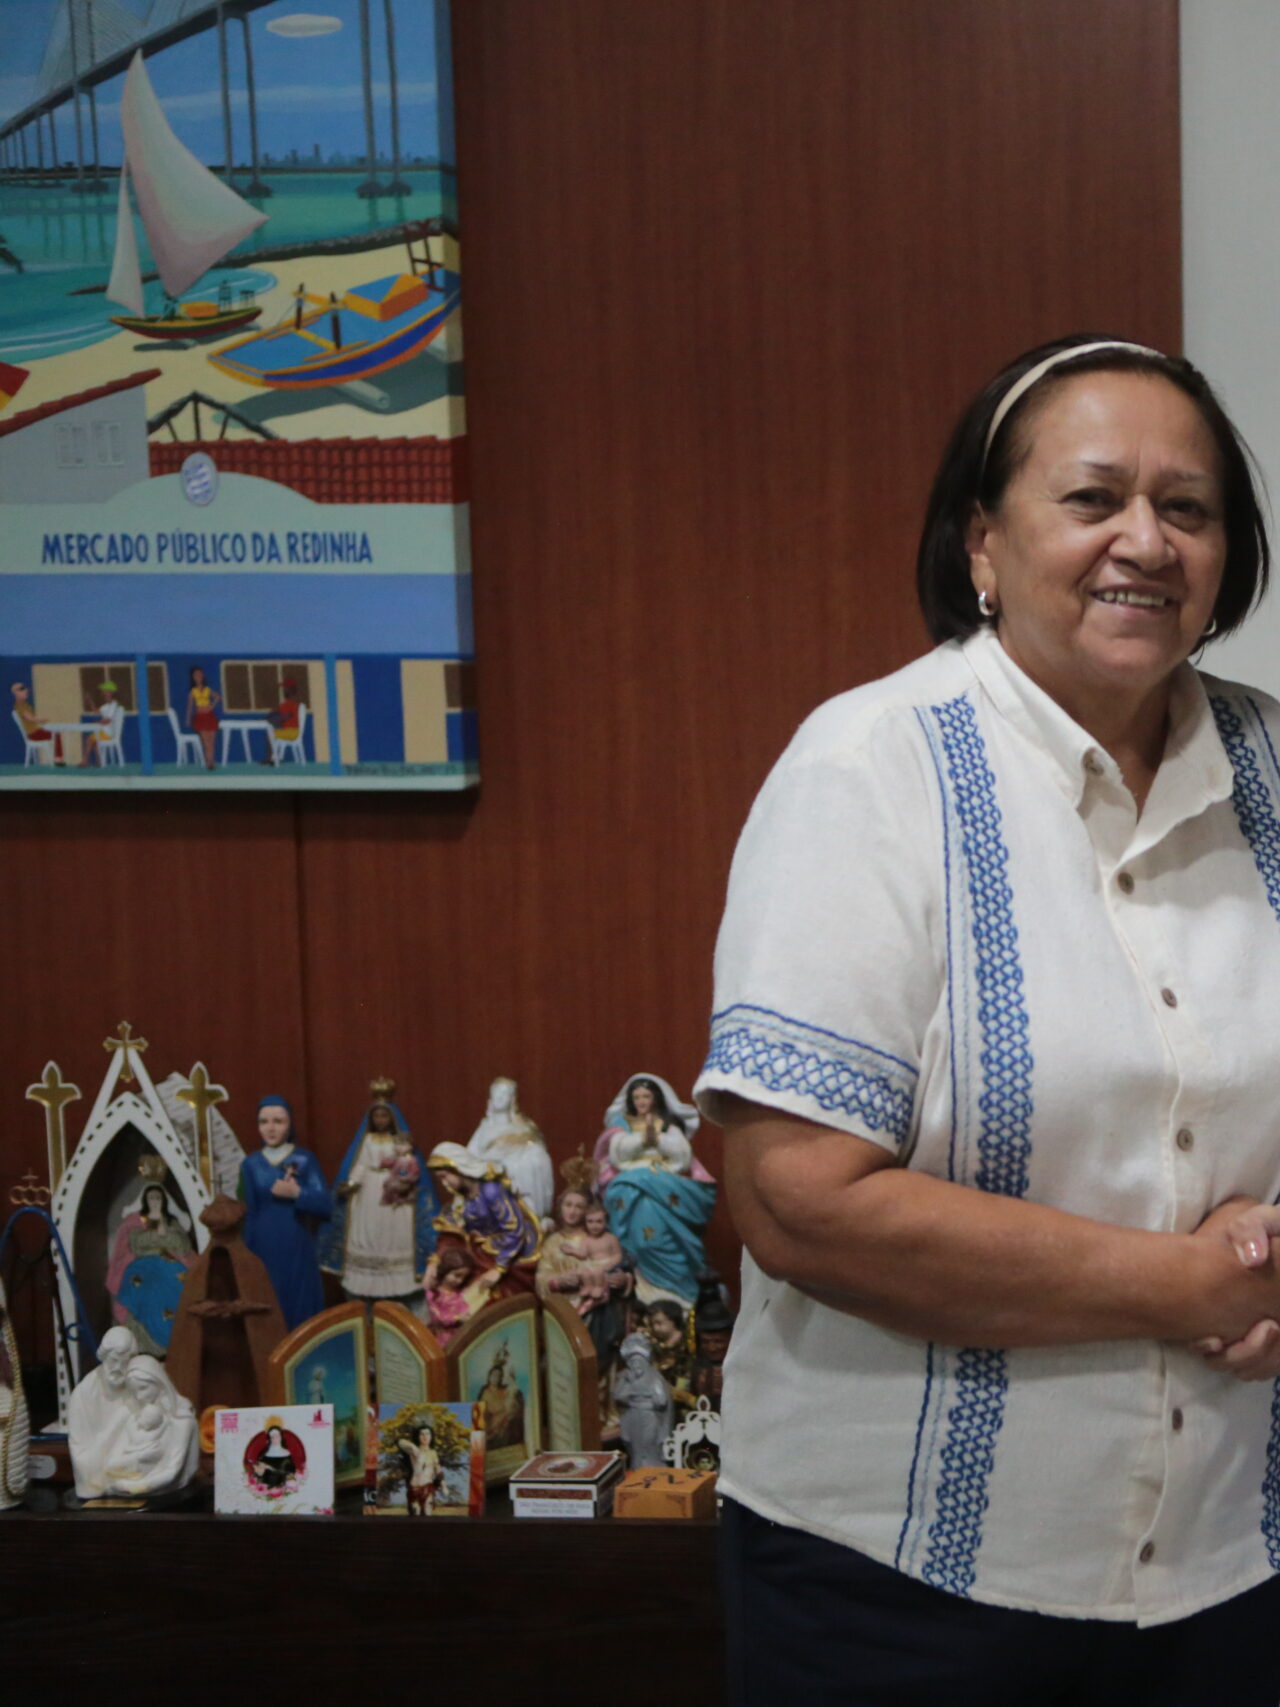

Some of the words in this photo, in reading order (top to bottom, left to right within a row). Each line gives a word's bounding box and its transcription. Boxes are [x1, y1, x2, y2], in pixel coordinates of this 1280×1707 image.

[42, 533, 149, 564] MERCADO
[157, 528, 247, 563] PÚBLICO
[252, 532, 282, 563] DA
[287, 532, 373, 563] REDINHA
